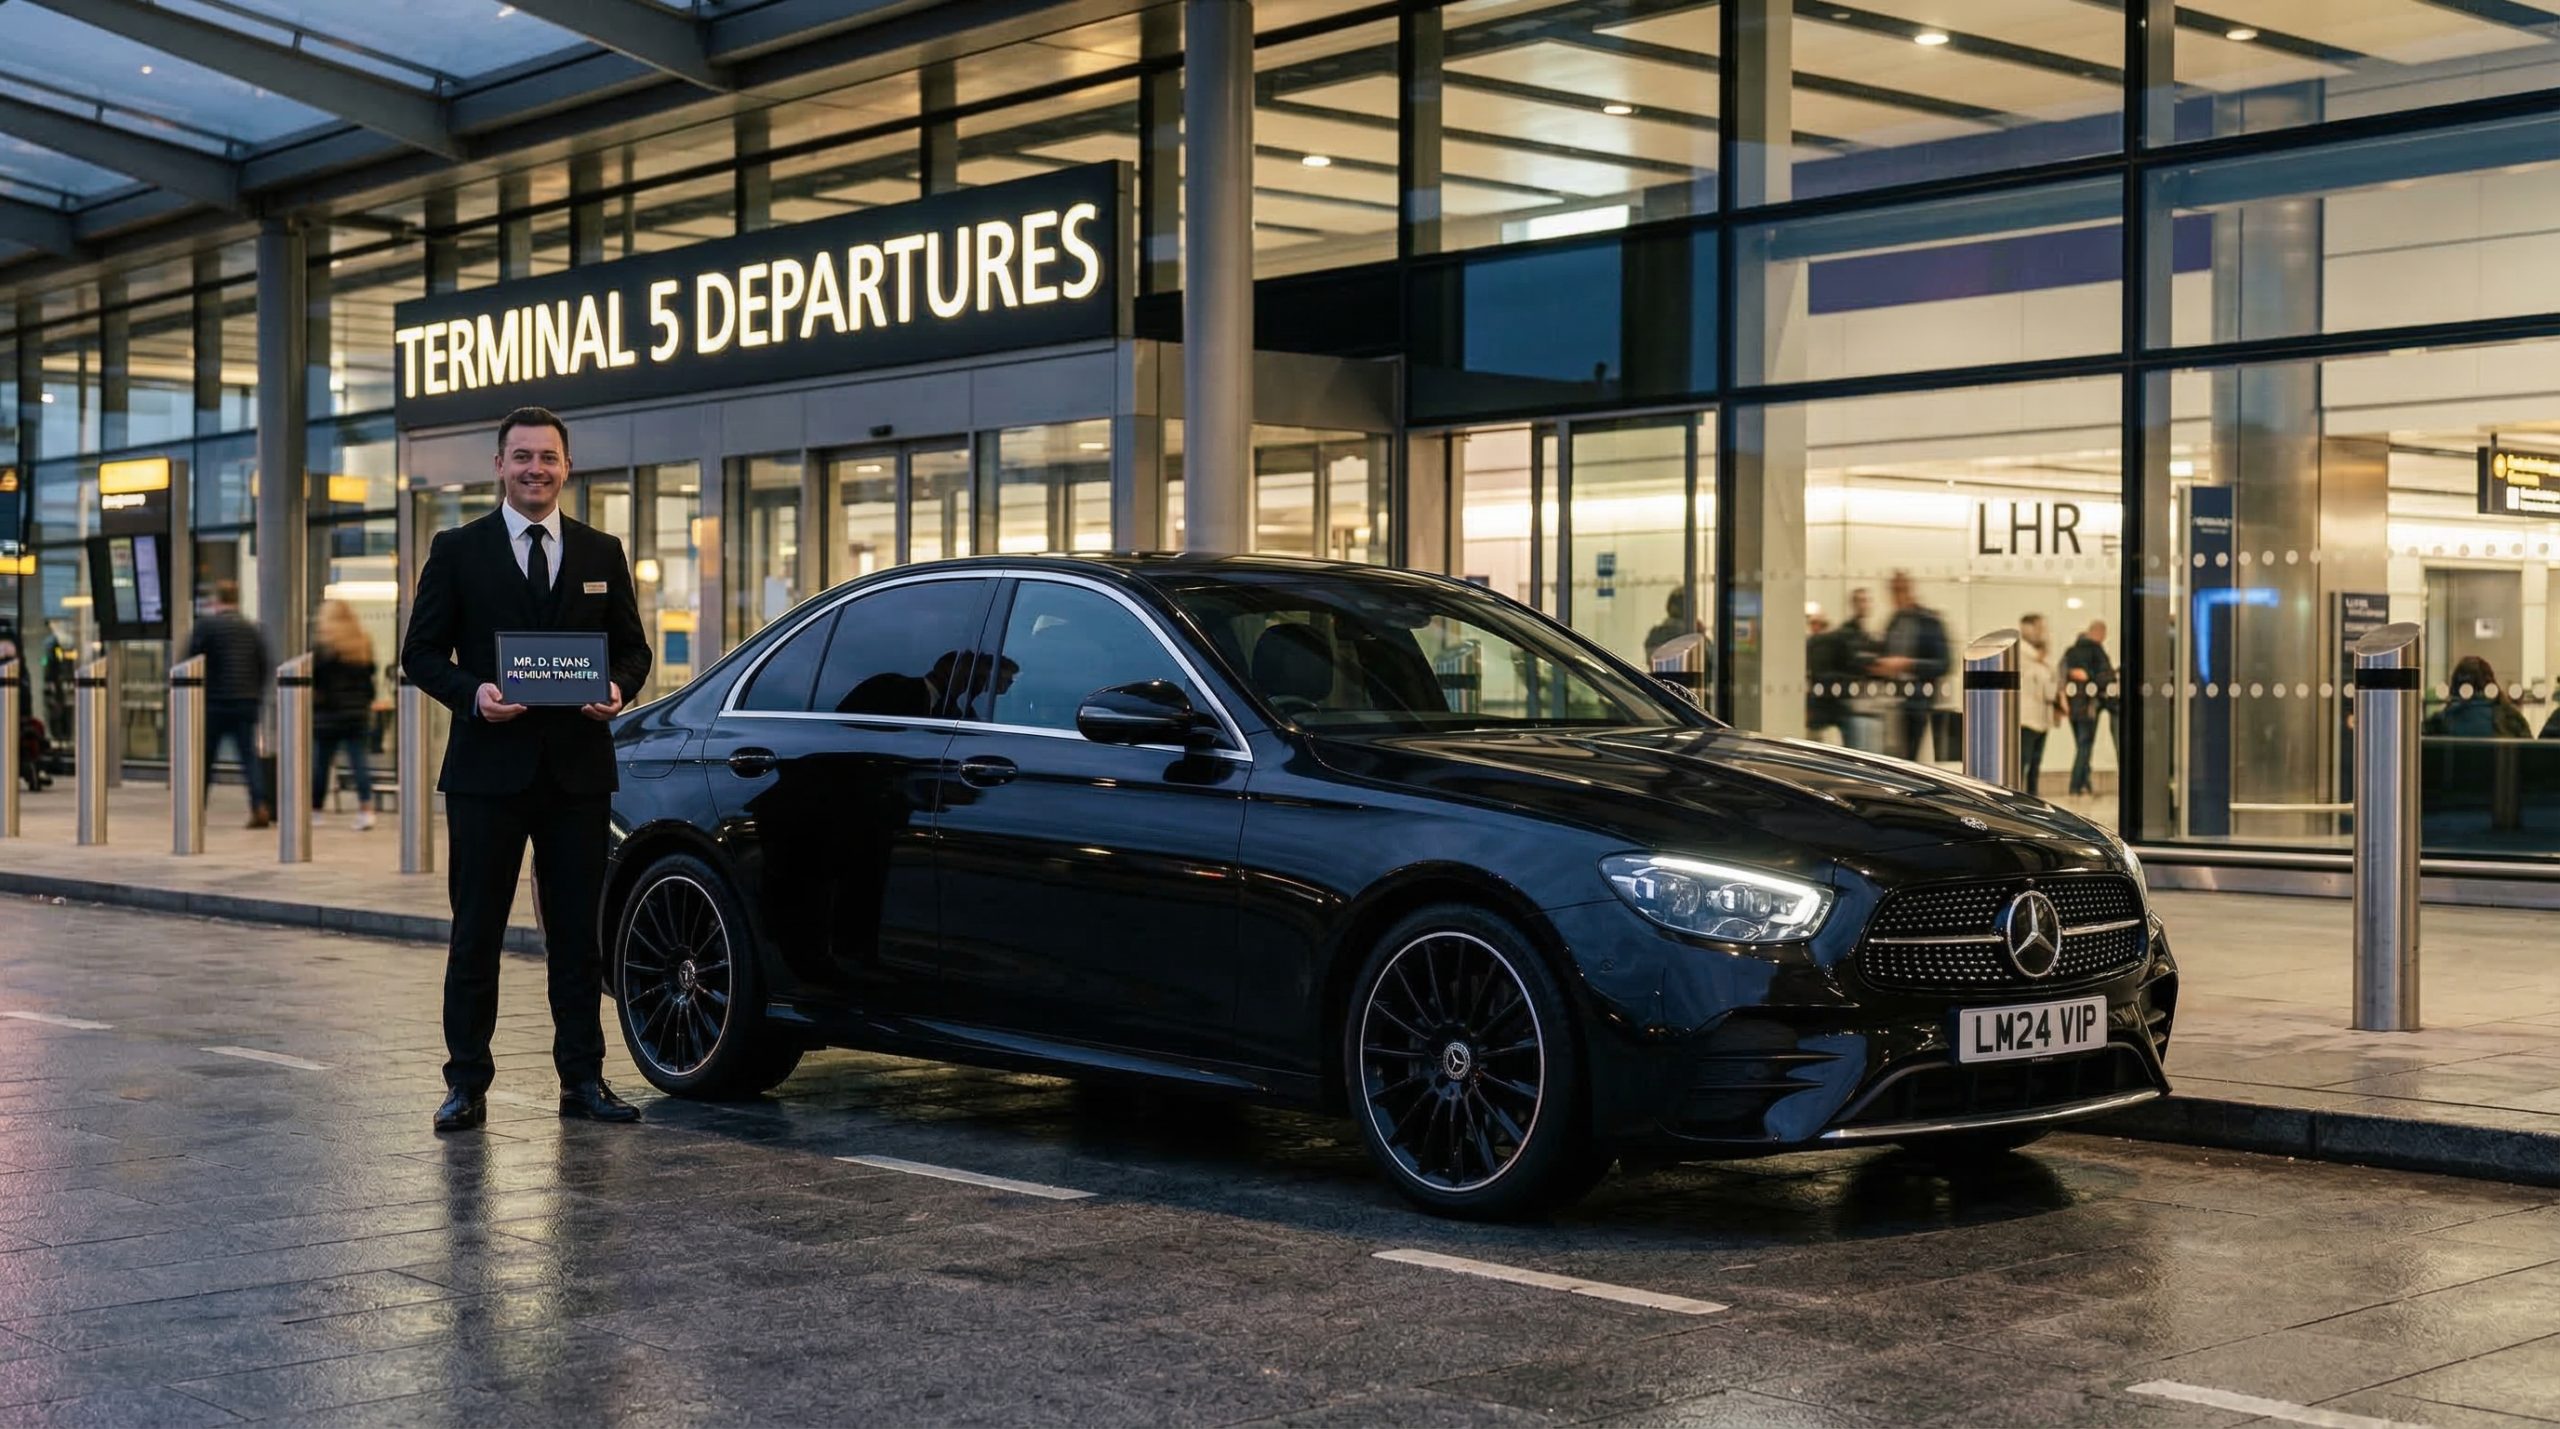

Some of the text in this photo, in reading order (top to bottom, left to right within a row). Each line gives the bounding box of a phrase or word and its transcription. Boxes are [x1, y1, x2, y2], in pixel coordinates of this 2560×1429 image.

[396, 203, 1099, 399] TERMINAL 5 DEPARTURES
[1979, 502, 2081, 554] LHR
[507, 670, 551, 679] PREMIUM
[514, 657, 590, 667] MR. D. EVANS
[1975, 1004, 2096, 1053] LM24 VIP
